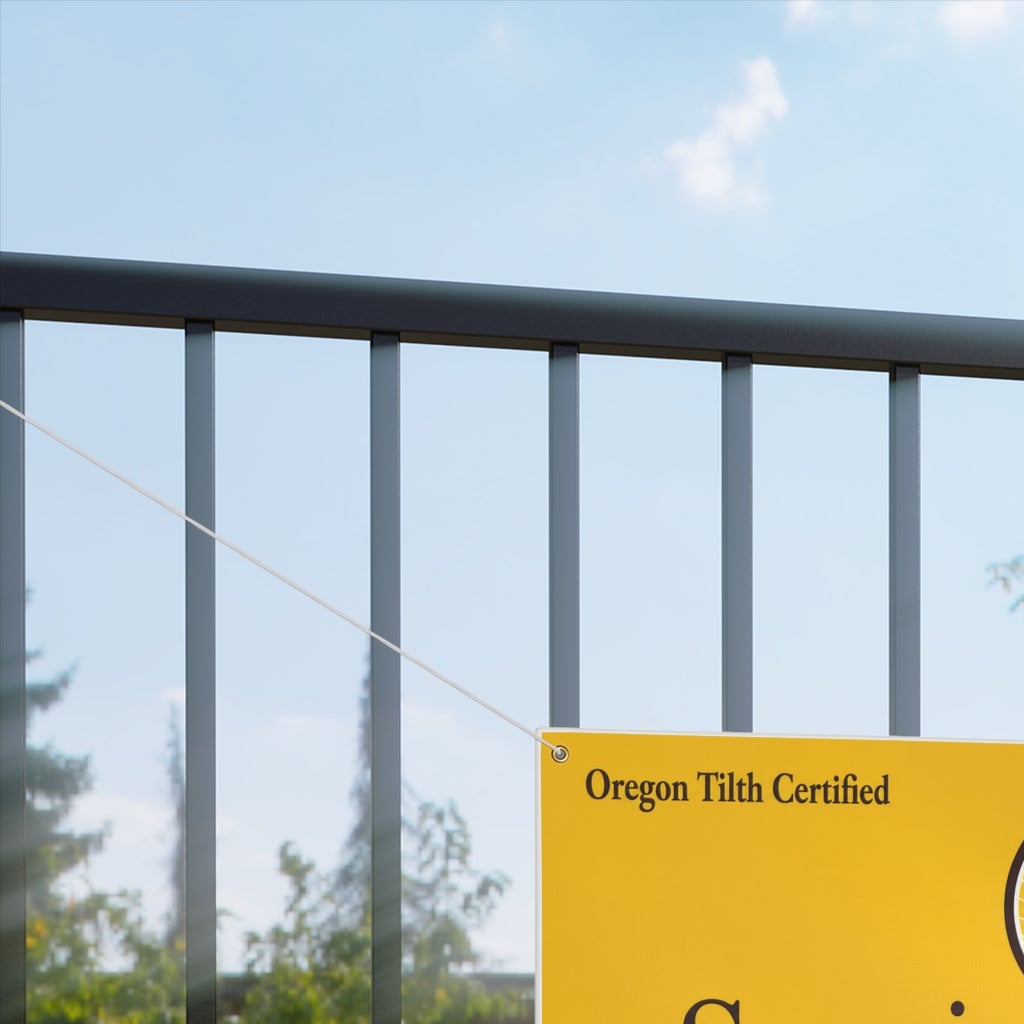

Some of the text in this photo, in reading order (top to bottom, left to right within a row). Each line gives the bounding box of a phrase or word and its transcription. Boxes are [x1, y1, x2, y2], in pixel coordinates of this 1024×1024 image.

[585, 768, 891, 813] Oregon Tilth Certified
